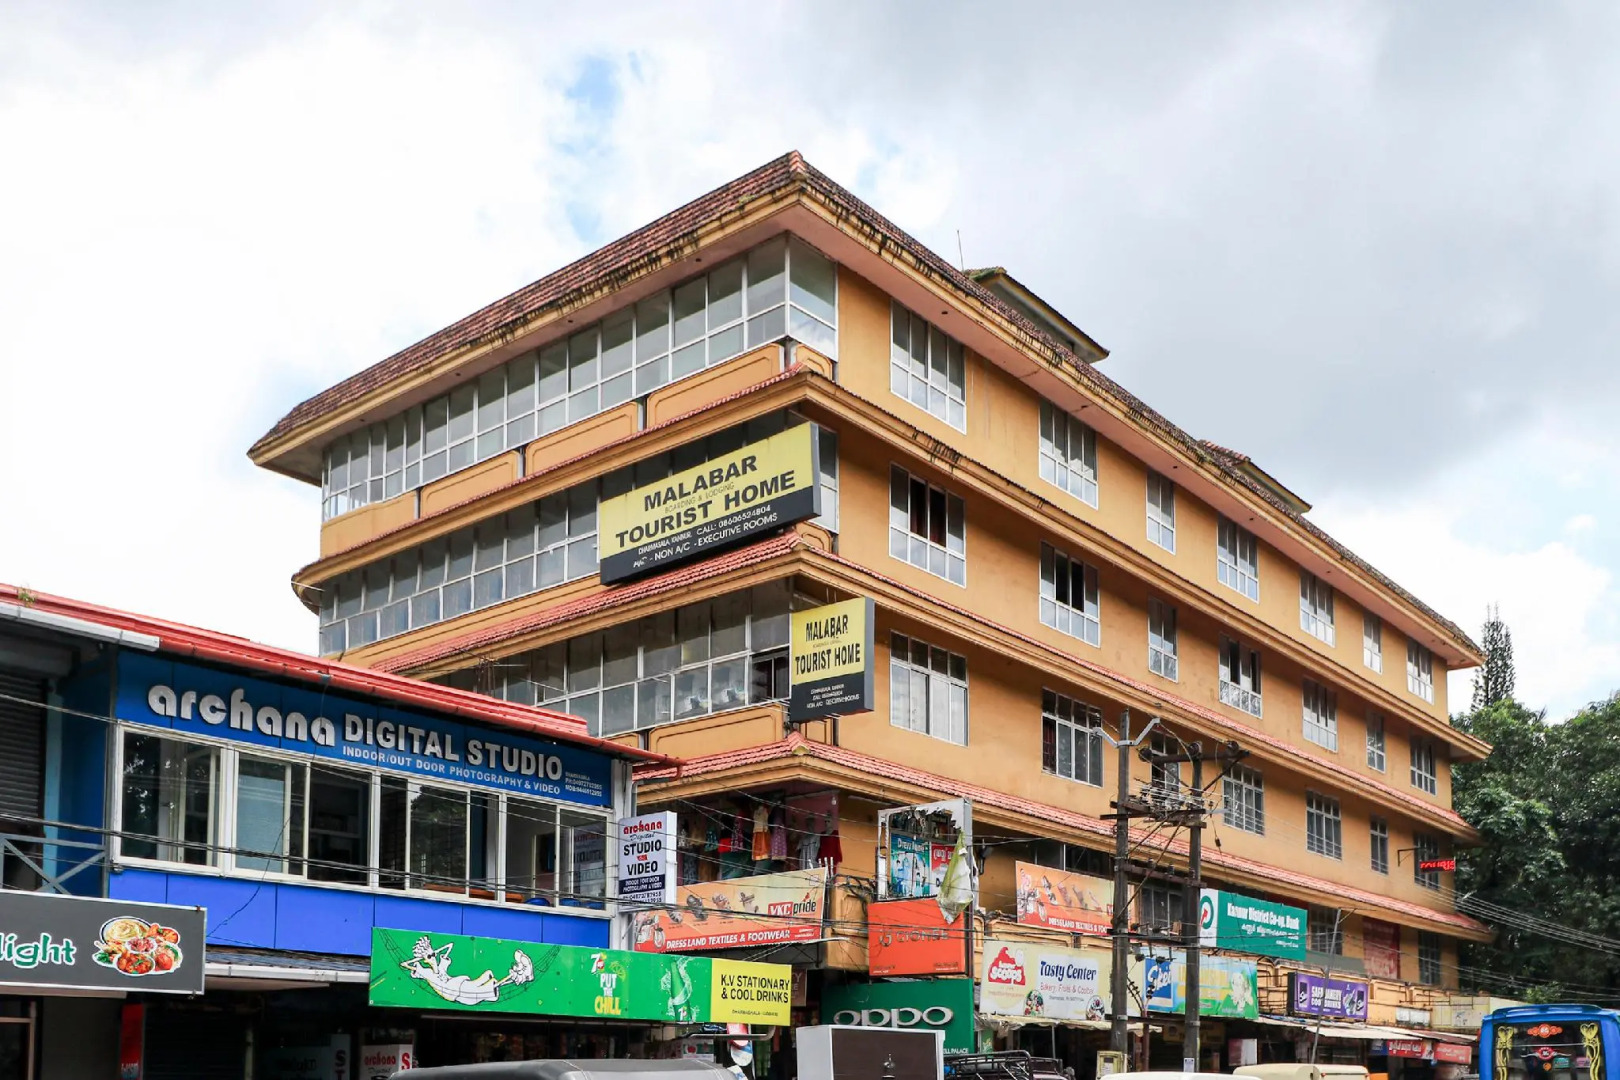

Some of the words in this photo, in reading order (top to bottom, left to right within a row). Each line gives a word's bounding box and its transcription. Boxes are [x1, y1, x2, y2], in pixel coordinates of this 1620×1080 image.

[644, 455, 758, 511] MALABAR
[615, 500, 713, 548] TOURIST
[725, 470, 796, 511] HOME
[654, 547, 675, 561] NON
[675, 541, 691, 556] A/C
[743, 512, 778, 532] ROOMS
[696, 523, 717, 535] CALL:
[805, 614, 849, 642] MALABAR
[795, 648, 832, 675] TOURIST
[834, 643, 861, 666] HOME
[148, 684, 336, 747] archana
[345, 713, 459, 762] DIGITAL
[467, 739, 563, 781] STUDIO
[416, 759, 446, 774] DOOR
[449, 766, 523, 789] PHOTOGRAPHY
[524, 781, 532, 789] &
[534, 782, 561, 795] VIDEO
[623, 820, 663, 835] archana
[623, 839, 662, 856] STUDIO
[627, 861, 658, 876] VIDEO
[769, 903, 792, 916] VKC
[793, 899, 817, 917] pride
[1248, 907, 1269, 924] District
[1286, 915, 1299, 930] Bank
[708, 933, 738, 945] TEXTILES
[739, 933, 745, 942] &
[747, 930, 790, 942] FOOTWEAR
[600, 973, 617, 989] PUT
[1040, 960, 1065, 982] Tasty
[1066, 963, 1097, 981] Center
[721, 974, 735, 987] K.V
[737, 975, 790, 991] STATIONARY
[594, 995, 621, 1015] CHILL
[721, 988, 728, 1000] &
[730, 988, 755, 1001] COOL
[756, 990, 789, 1004] DRINKS
